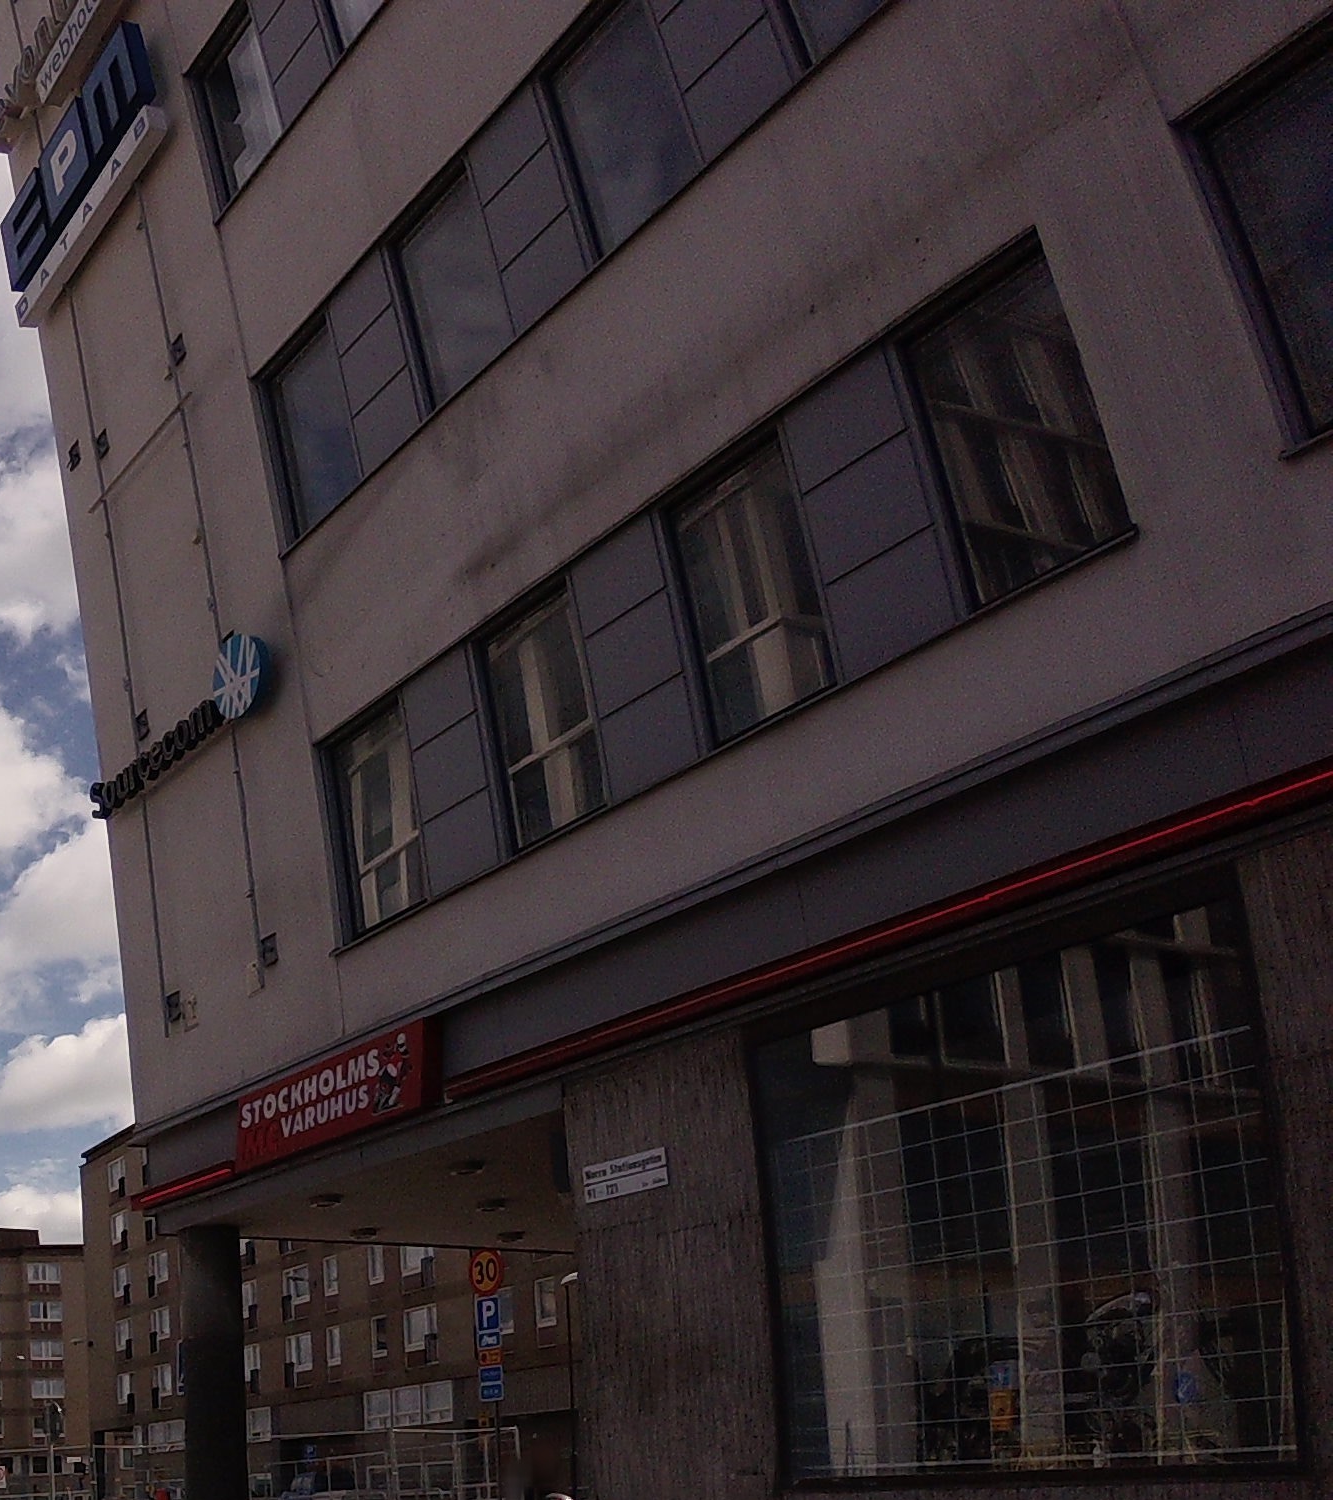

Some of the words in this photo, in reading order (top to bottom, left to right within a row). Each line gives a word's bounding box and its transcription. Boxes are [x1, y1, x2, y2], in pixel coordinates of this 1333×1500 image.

[1, 21, 153, 291] EPM
[90, 699, 225, 819] Sourcecom
[241, 1048, 381, 1129] STOCKHOLMS
[280, 1085, 370, 1138] VARUHUS
[474, 1257, 498, 1285] 30
[482, 1300, 496, 1329] P
